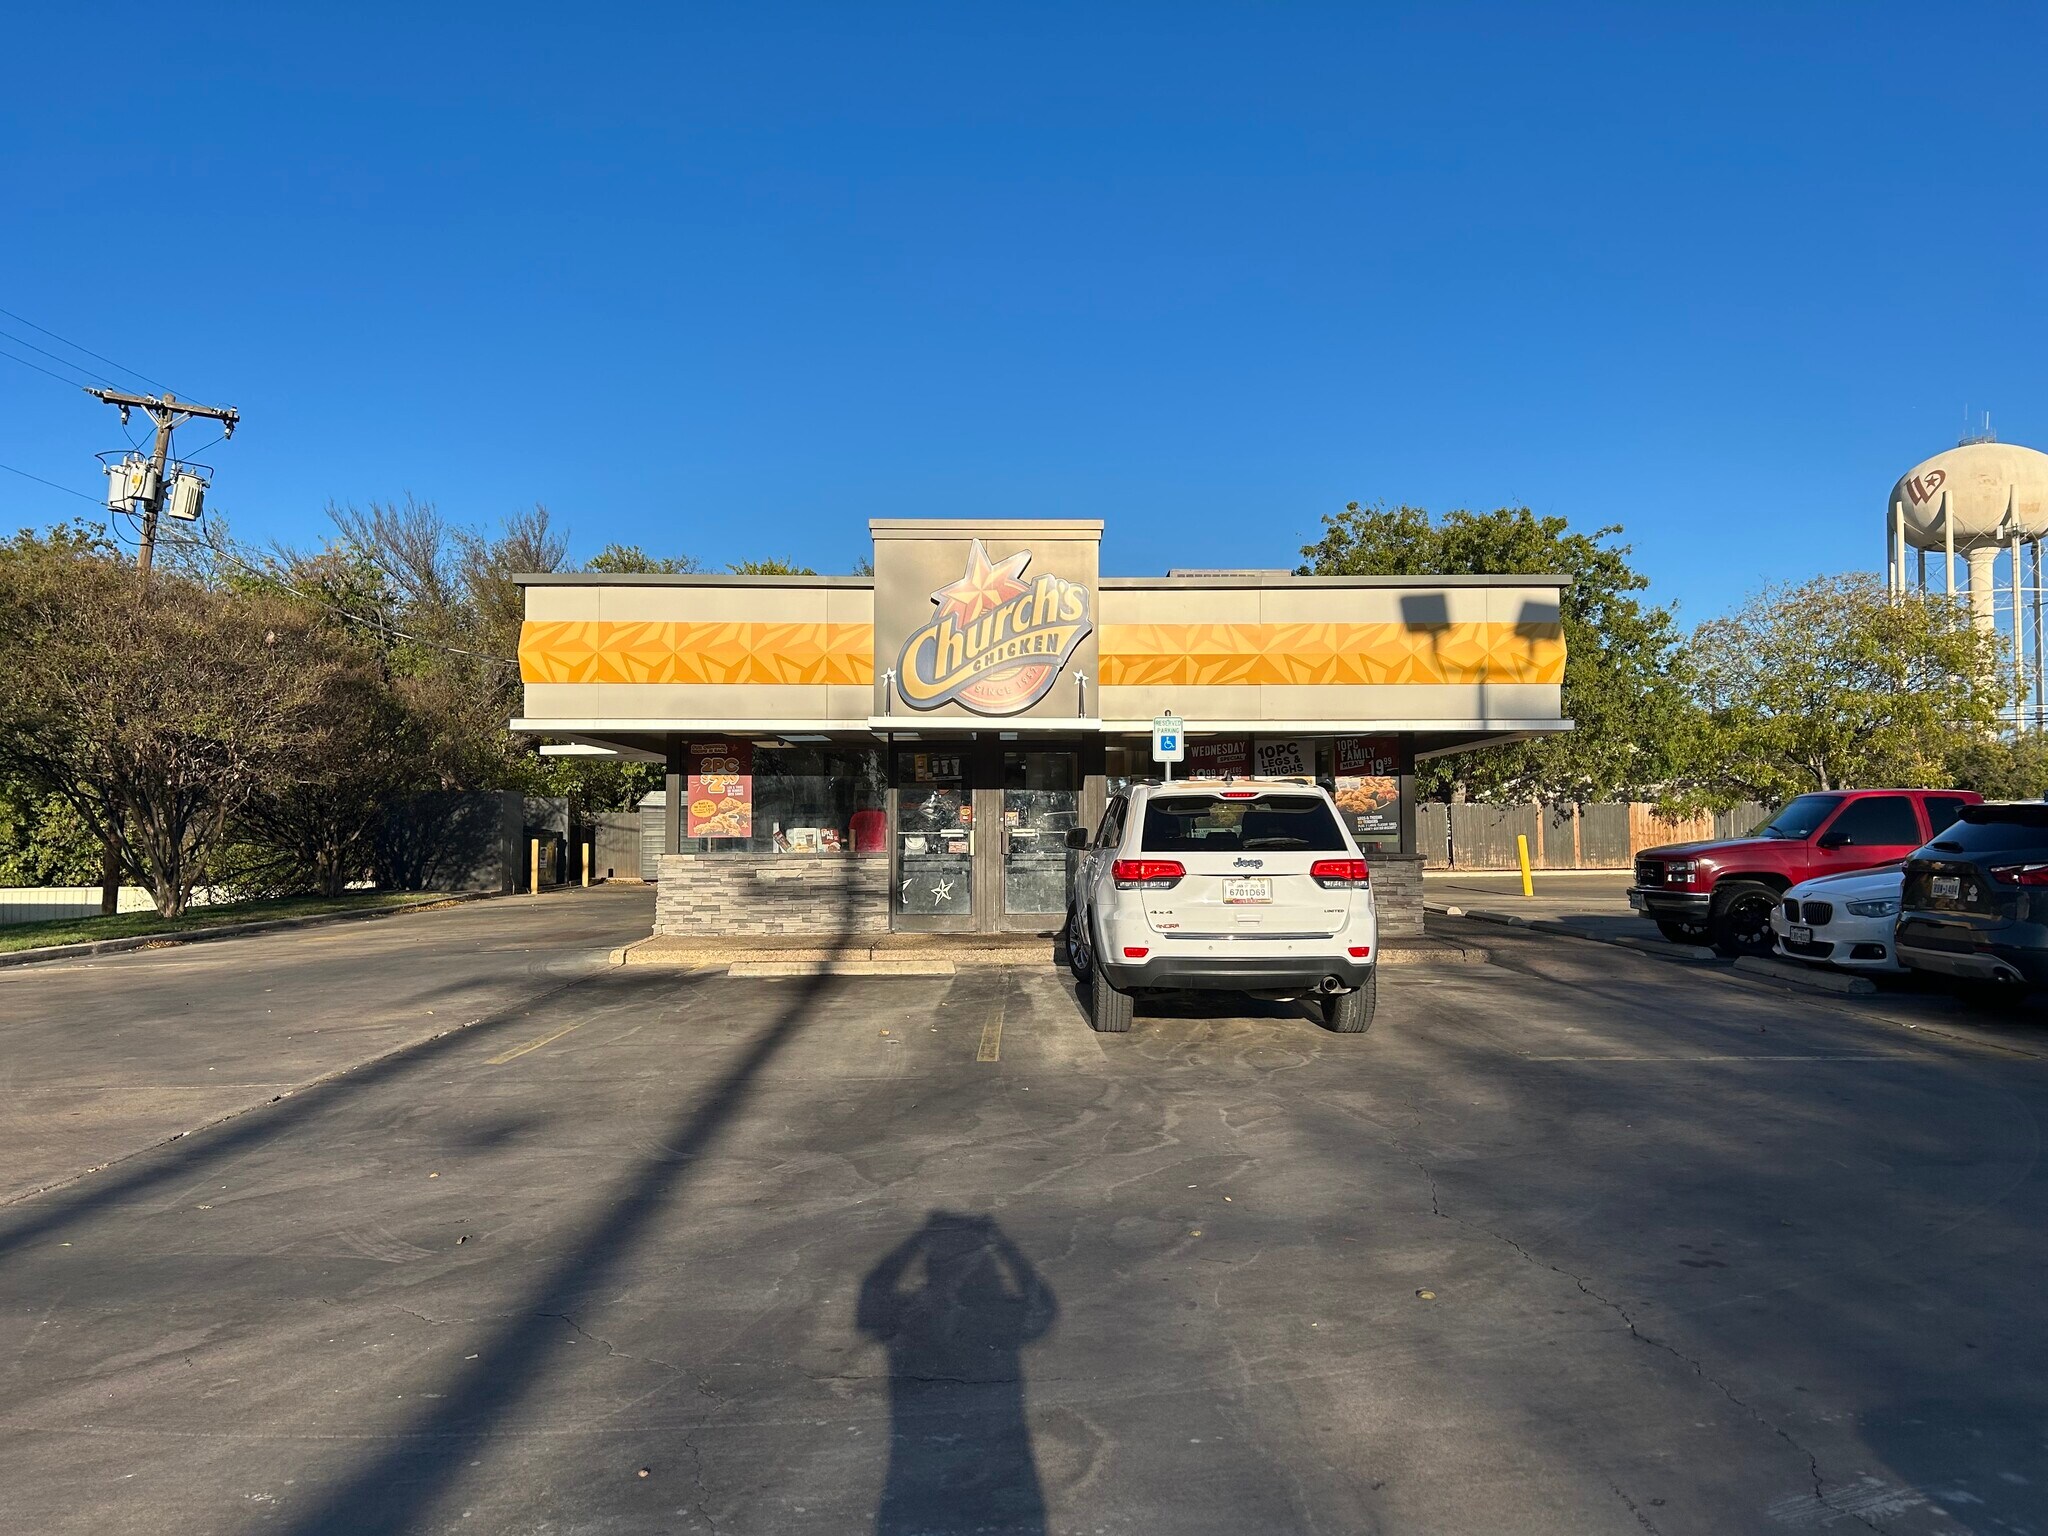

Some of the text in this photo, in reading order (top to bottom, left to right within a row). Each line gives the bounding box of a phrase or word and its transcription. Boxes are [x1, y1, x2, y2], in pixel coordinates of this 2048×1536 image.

[902, 577, 1083, 700] Church's
[973, 633, 1059, 671] CHICKEN
[974, 684, 1013, 697] SINCE
[1191, 741, 1246, 758] WEDNESDAY
[1257, 742, 1299, 759] 10PC
[1336, 738, 1359, 751] 10PC
[1219, 754, 1244, 762] SPECIAL
[1340, 746, 1376, 761] FAMILY
[701, 757, 740, 773] 2PC
[1261, 755, 1302, 769] LEGS &
[1342, 760, 1363, 770] MEAL
[1262, 763, 1305, 777] THIGHS
[1232, 857, 1264, 869] Jeep
[1230, 888, 1266, 897] 6701D69
